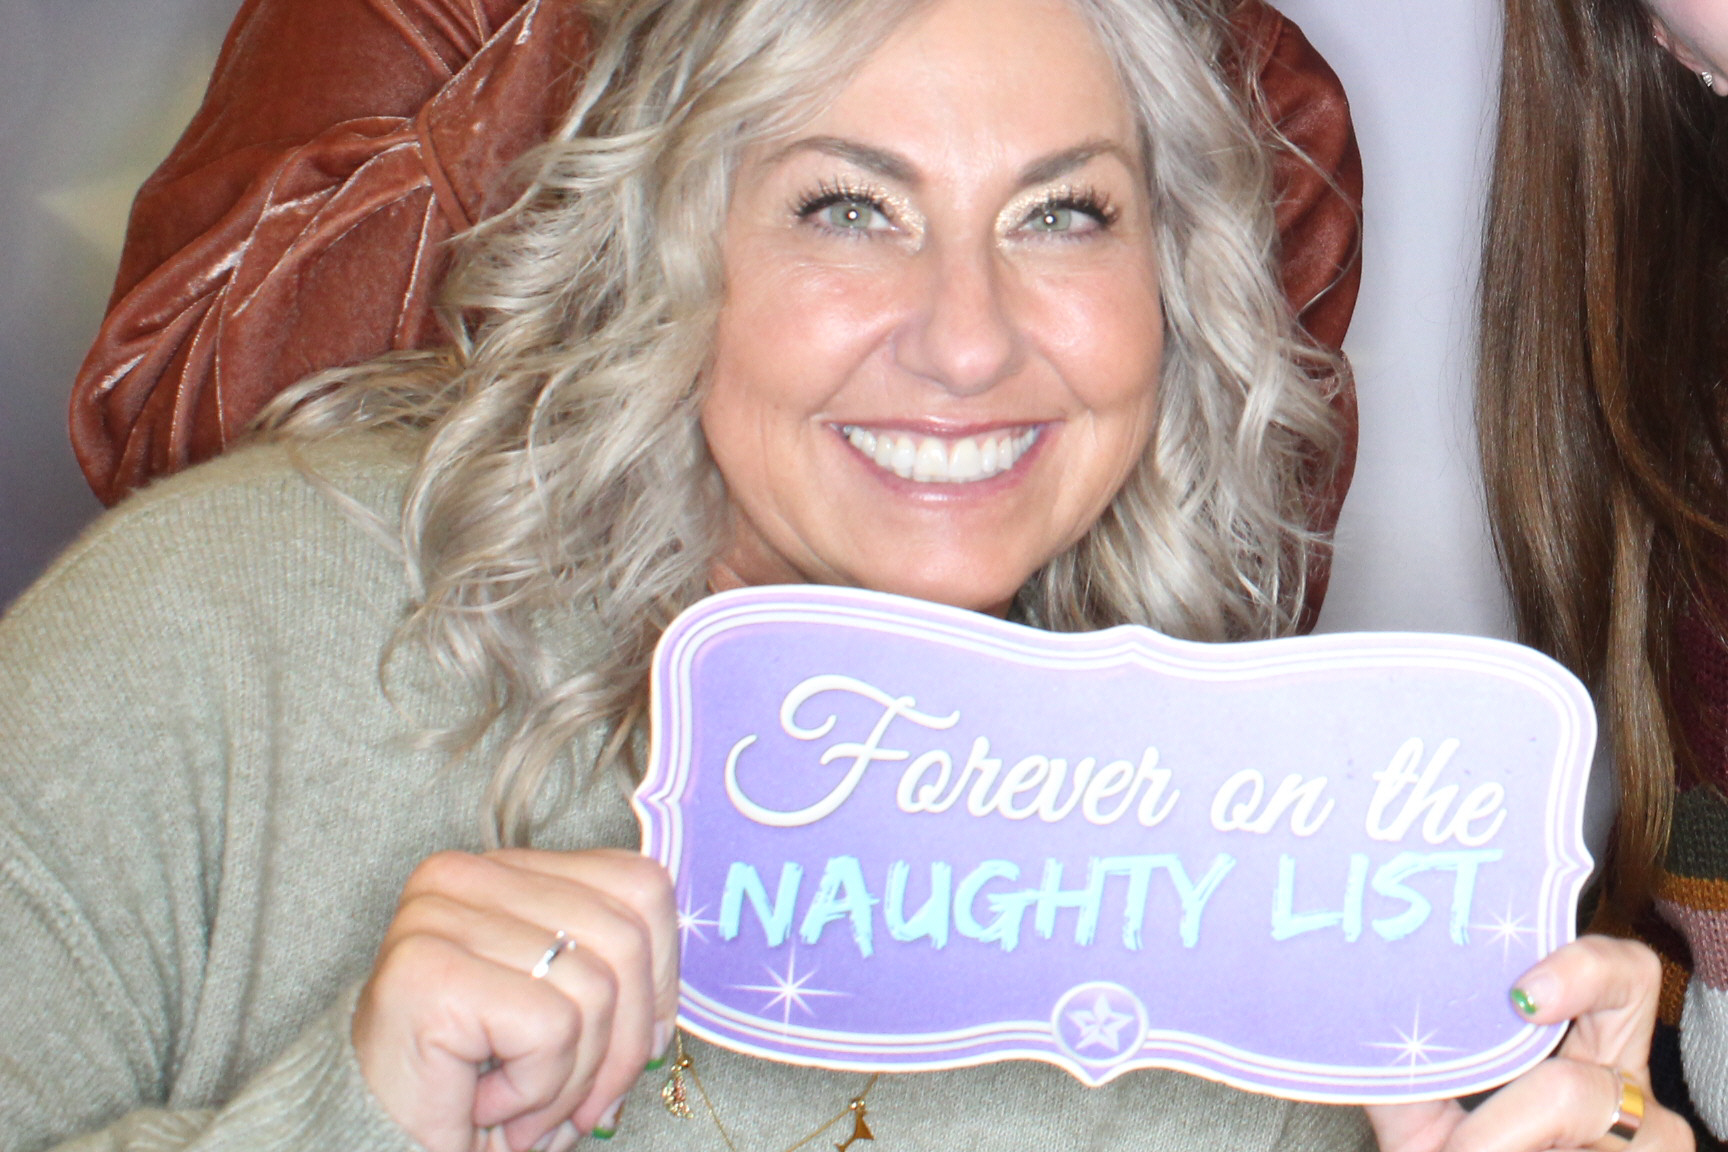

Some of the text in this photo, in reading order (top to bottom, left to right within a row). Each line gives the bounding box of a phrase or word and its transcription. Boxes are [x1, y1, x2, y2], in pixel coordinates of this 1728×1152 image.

[724, 674, 1508, 847] Forever on the
[718, 848, 1503, 958] NAUGHTY LIST
